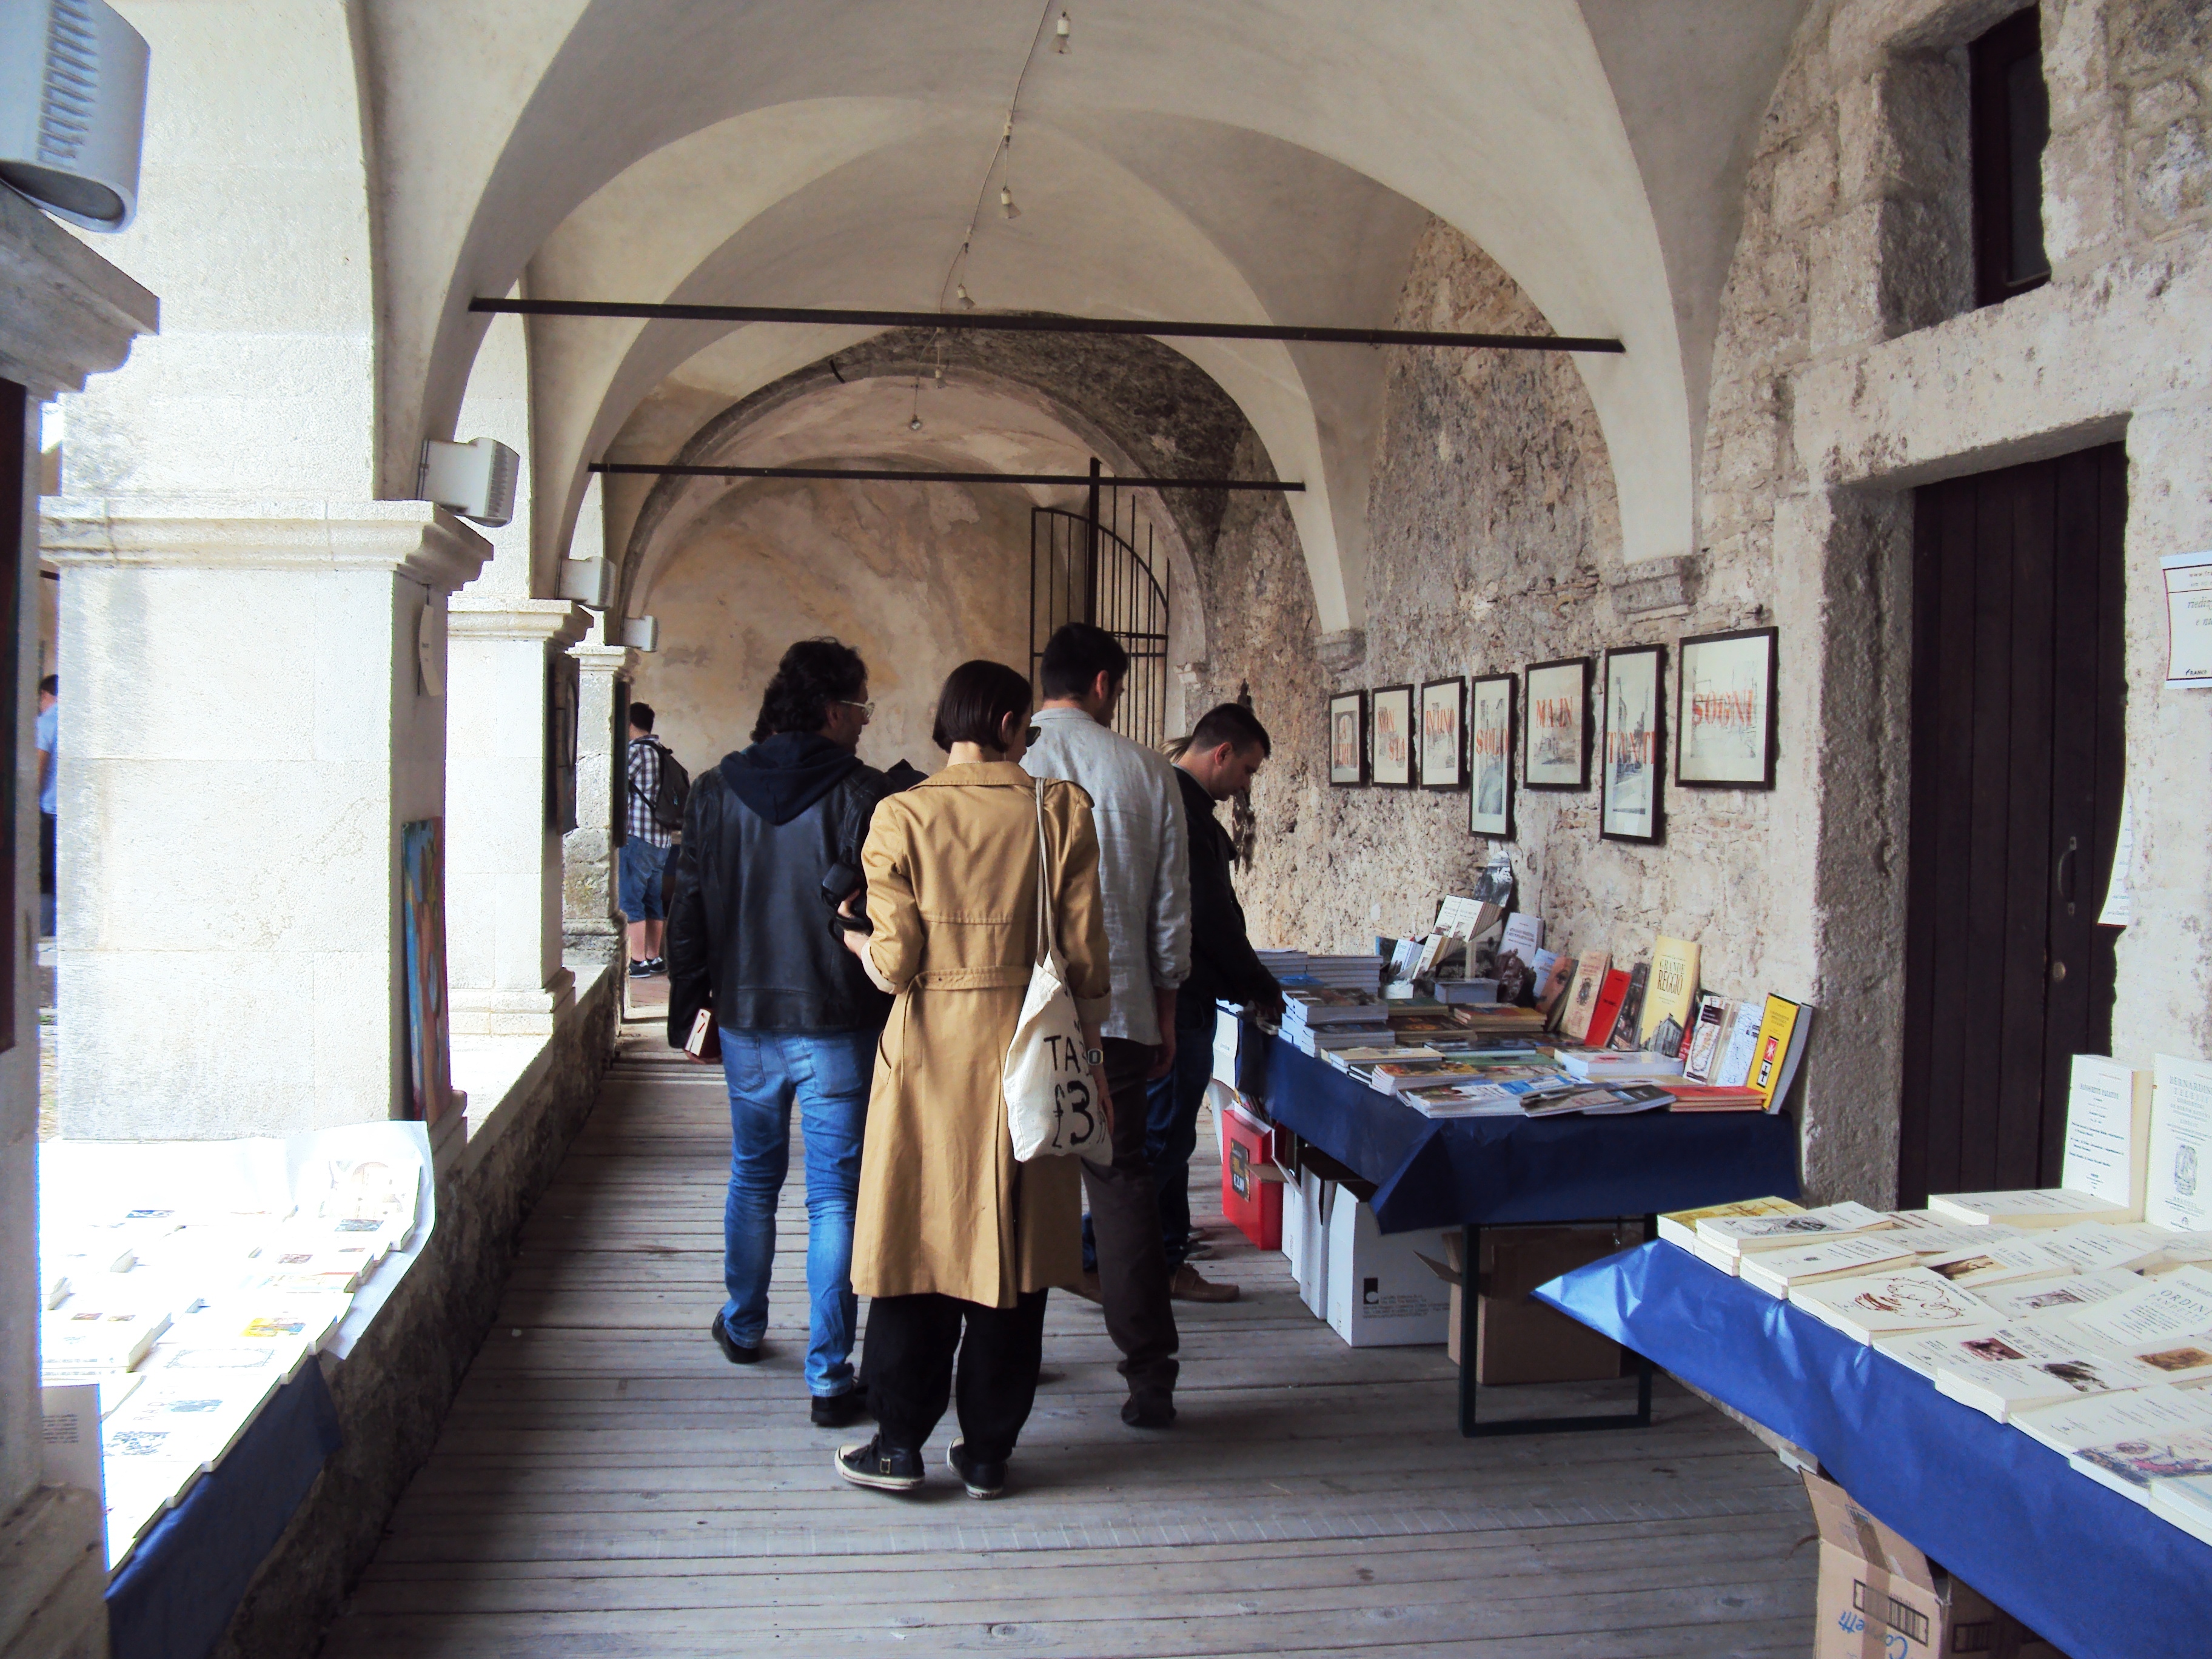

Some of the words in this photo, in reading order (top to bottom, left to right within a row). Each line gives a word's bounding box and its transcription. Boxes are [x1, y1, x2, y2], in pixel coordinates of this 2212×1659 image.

[1692, 689, 1753, 726] SOGNI
[1476, 728, 1509, 756] SOLO
[1608, 730, 1655, 765] TANTI
[1659, 959, 1686, 974] GRANDE
[1657, 970, 1684, 996] REGGIO
